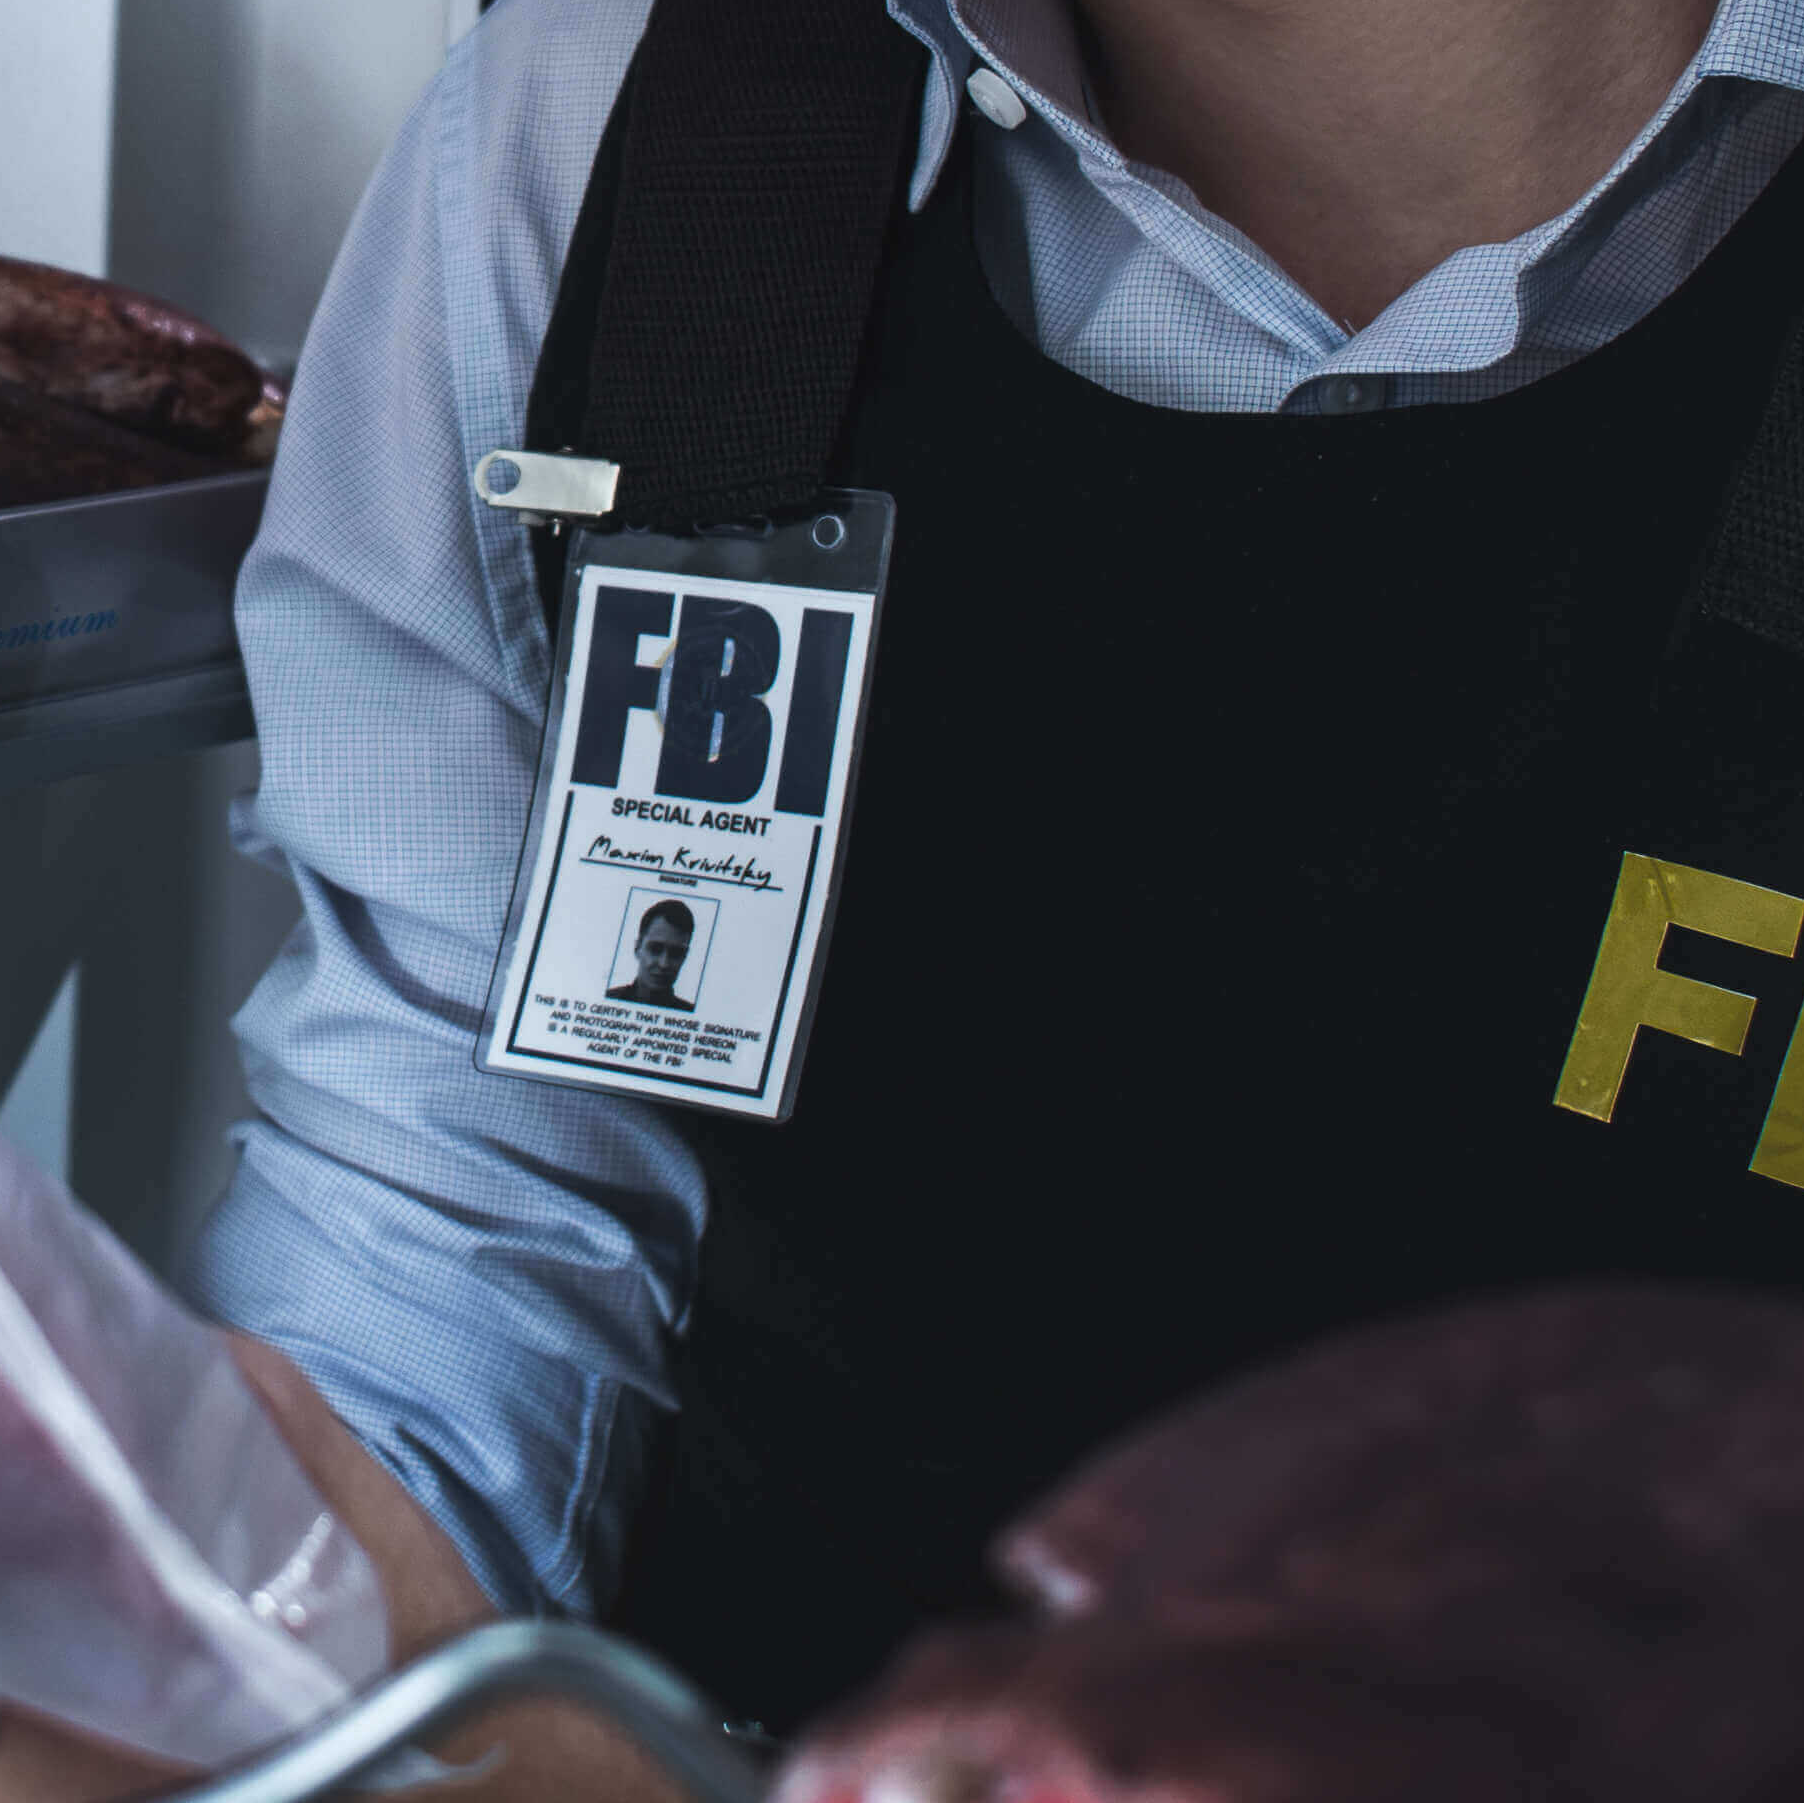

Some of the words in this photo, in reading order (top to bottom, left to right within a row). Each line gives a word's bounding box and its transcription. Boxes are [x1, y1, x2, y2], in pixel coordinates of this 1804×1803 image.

[570, 586, 855, 817] FBI
[611, 797, 694, 826] SPECIAL
[699, 810, 772, 836] AGENT
[673, 846, 772, 891] Krivitsky
[535, 994, 555, 1007] THIS
[560, 998, 569, 1008] IS
[574, 1000, 587, 1011] TO
[590, 1003, 632, 1019] CERTIFY
[635, 1010, 660, 1025] THAT
[664, 1014, 699, 1032] WHOSE
[704, 1023, 762, 1041] SIGNATURE
[550, 1010, 571, 1021] AND
[574, 1014, 642, 1034] PHOTOGRAPH
[645, 1026, 690, 1043] APPEARS
[694, 1035, 738, 1051] HEREON
[547, 1022, 556, 1032] IS
[560, 1024, 568, 1034] A
[571, 1026, 628, 1045] REGULARLY
[632, 1036, 688, 1056] APPOINTED
[691, 1046, 733, 1063] SPECIAL
[586, 1043, 620, 1057] AGENT
[624, 1048, 638, 1058] OF
[643, 1051, 661, 1063] THE
